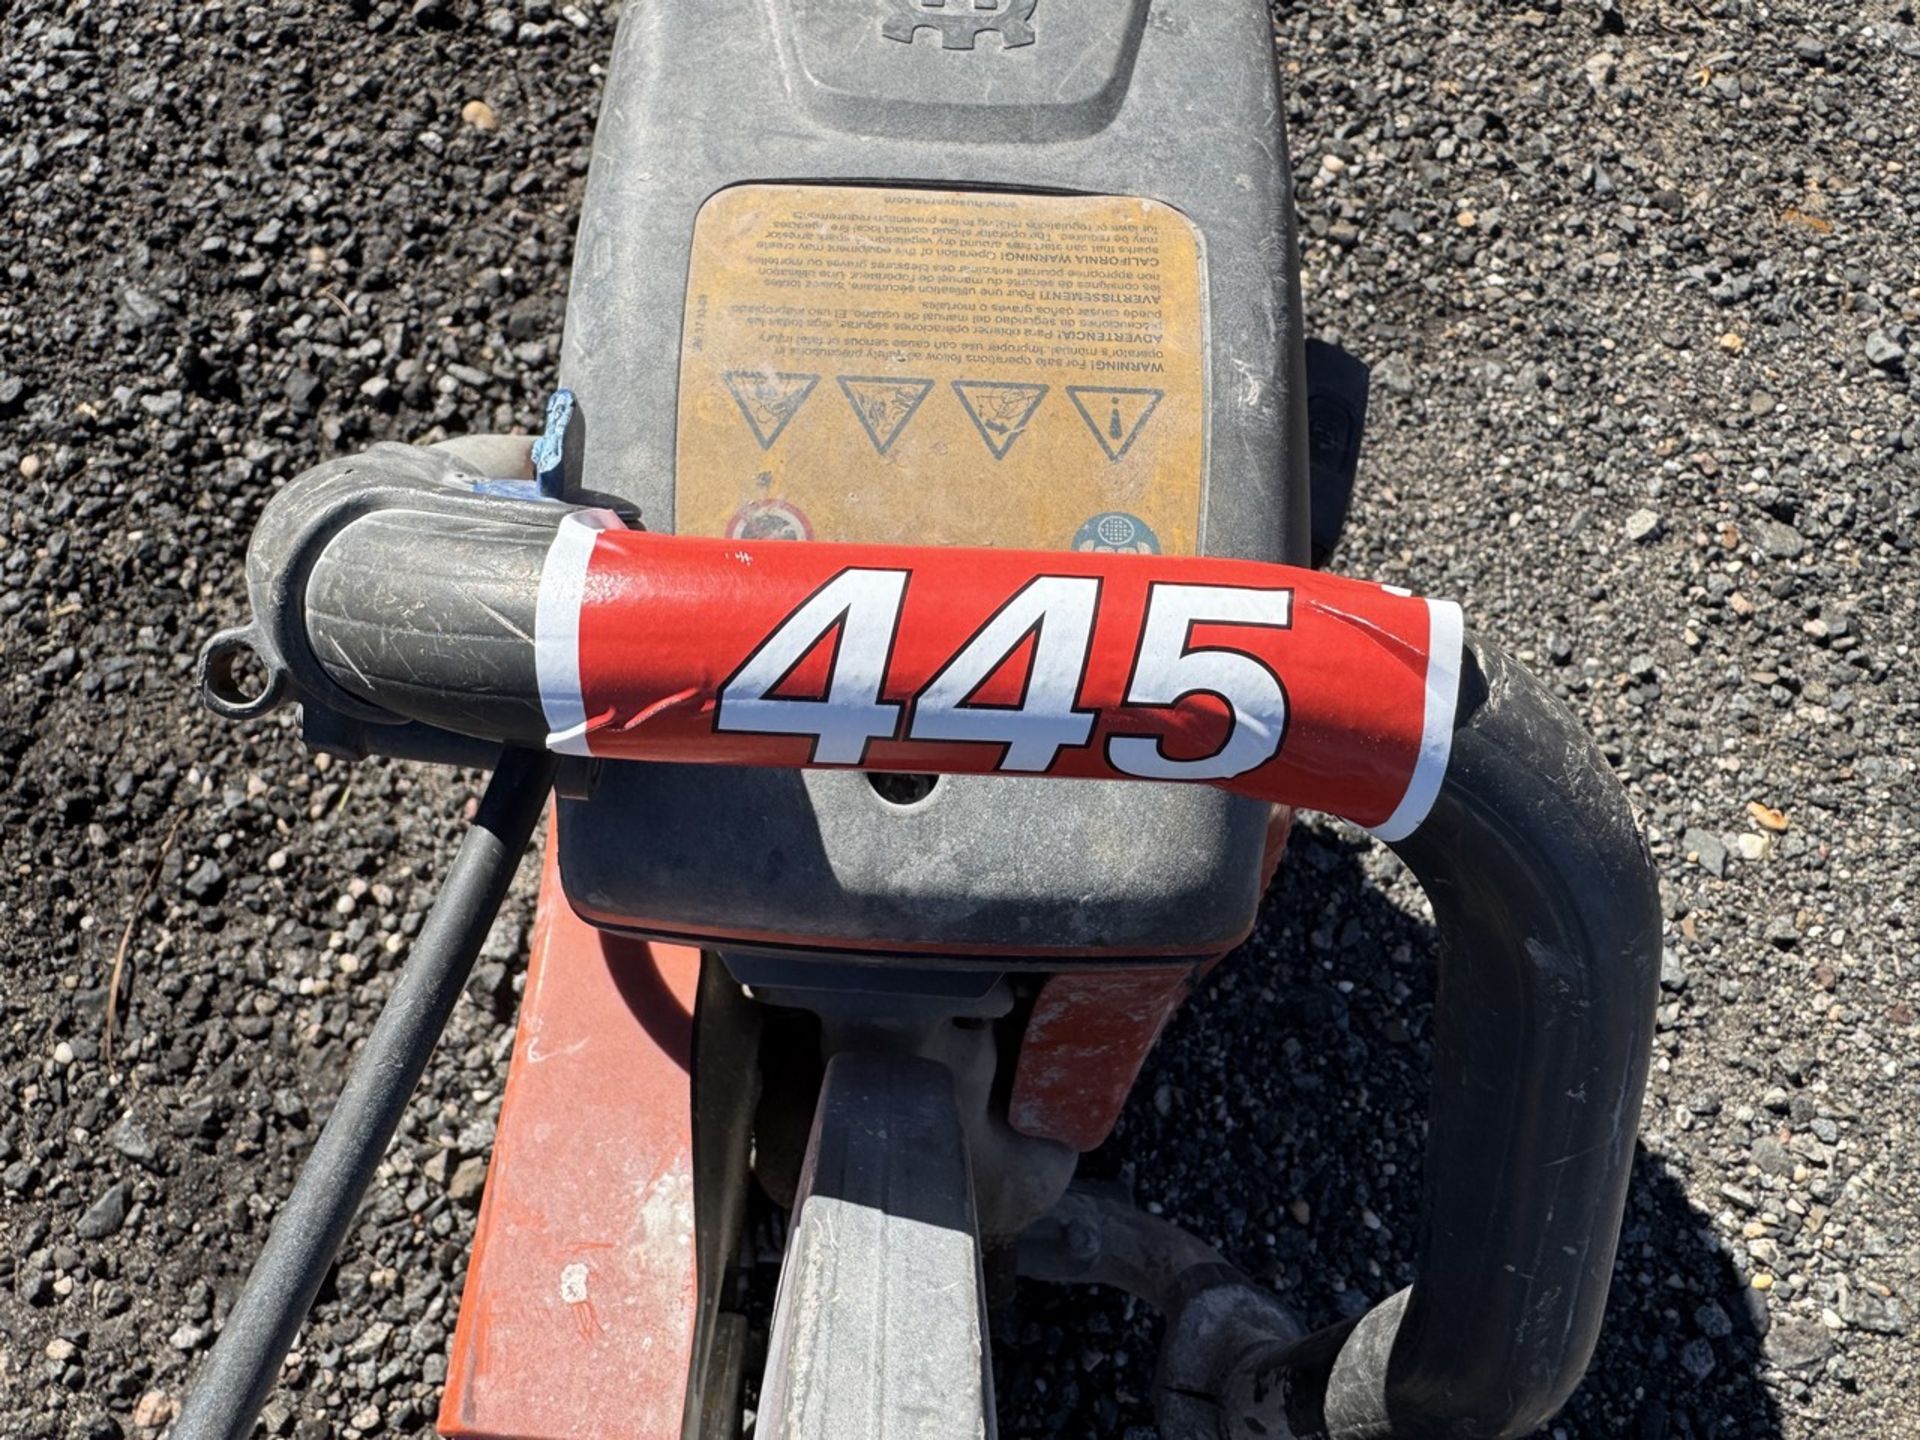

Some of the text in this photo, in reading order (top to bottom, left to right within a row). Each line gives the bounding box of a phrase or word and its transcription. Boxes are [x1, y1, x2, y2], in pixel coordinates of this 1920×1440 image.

[1001, 252, 1071, 263] WARNING!
[1076, 255, 1159, 267] CALIFORNIA
[1040, 291, 1161, 304] AVERTISSEMENT!
[1057, 331, 1163, 344] ADVERTENCIA!
[1091, 361, 1164, 372] WARNING!
[713, 566, 1294, 781] 445
